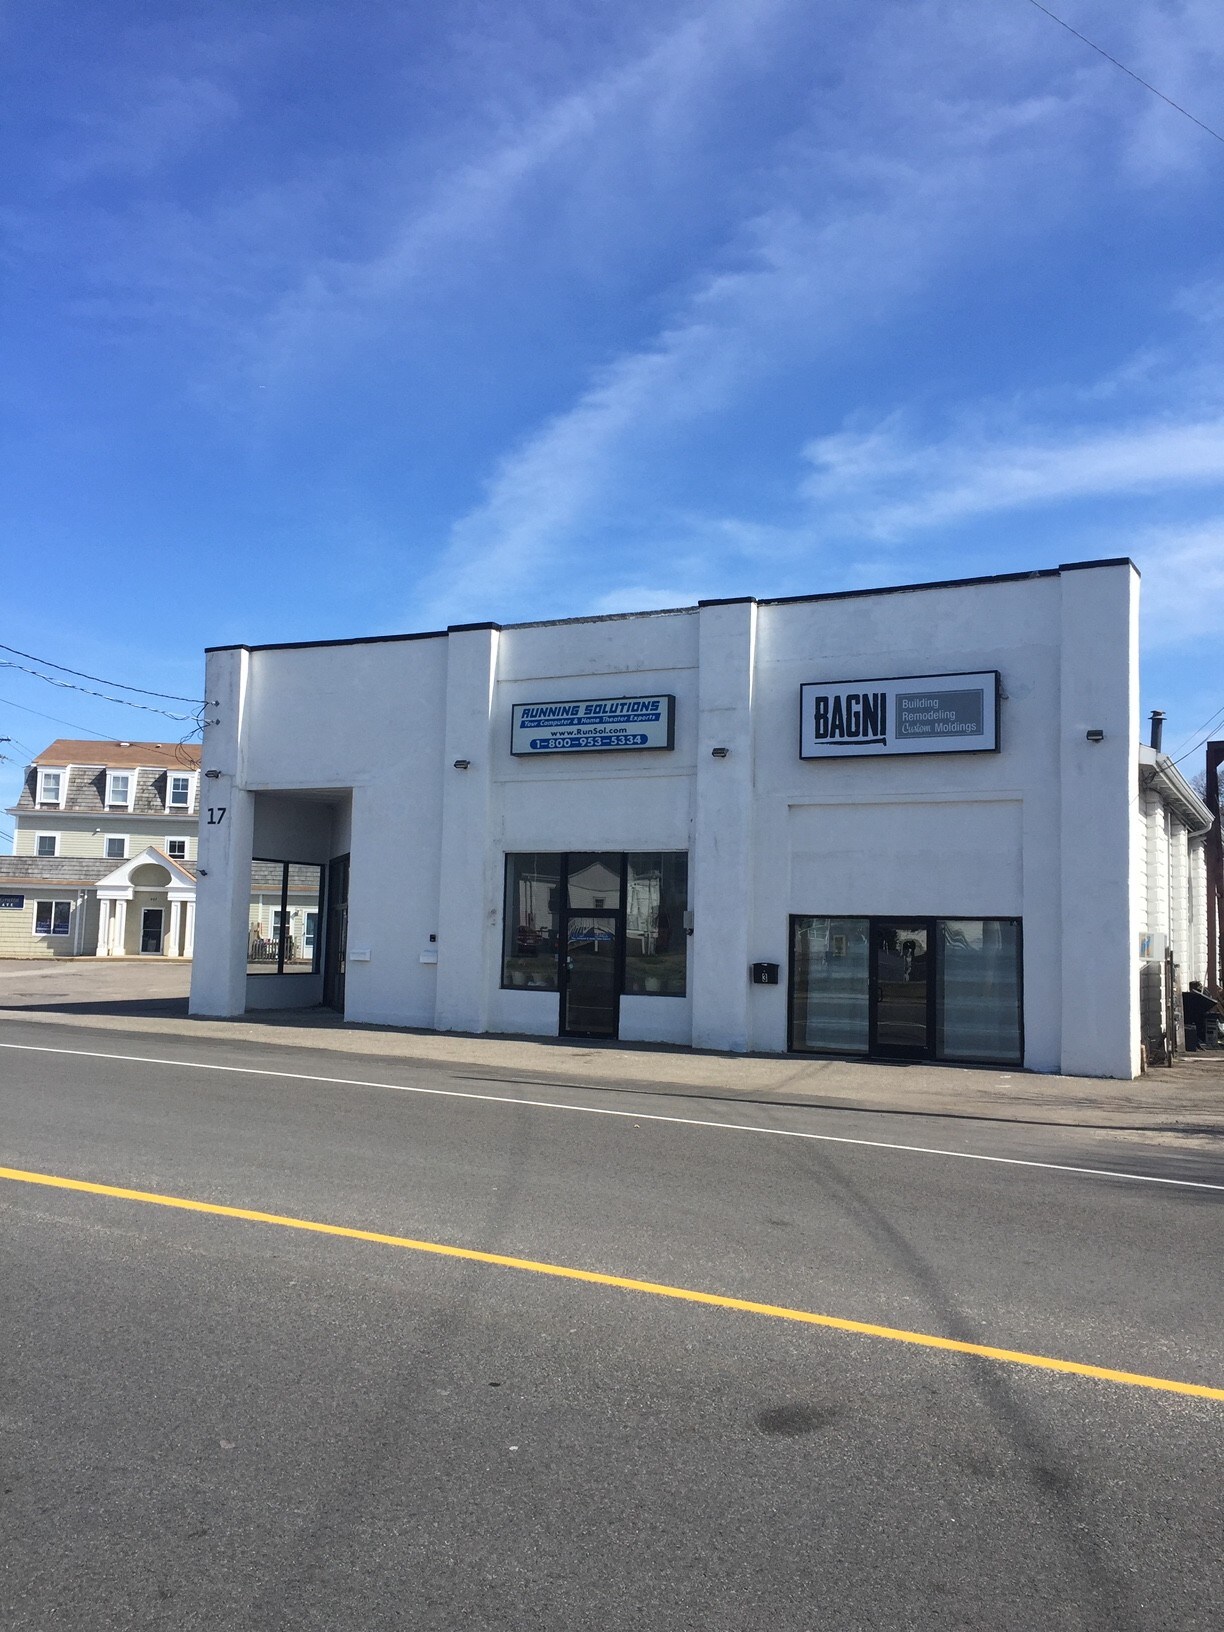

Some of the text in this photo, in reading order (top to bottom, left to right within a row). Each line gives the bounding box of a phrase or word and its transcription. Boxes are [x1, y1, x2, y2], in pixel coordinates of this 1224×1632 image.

[521, 700, 660, 719] RUNNING SOLUTIONS
[902, 698, 939, 709] Building
[540, 719, 571, 727] Computer
[602, 715, 628, 723] Theater
[629, 714, 656, 722] Experts
[814, 692, 887, 739] BAGNI
[902, 709, 956, 721] Remodeling
[550, 726, 628, 737] www.RunSol.com
[901, 721, 977, 734] Custom Moldings
[535, 735, 642, 749] 1-800-953-5334
[207, 807, 227, 825] 17
